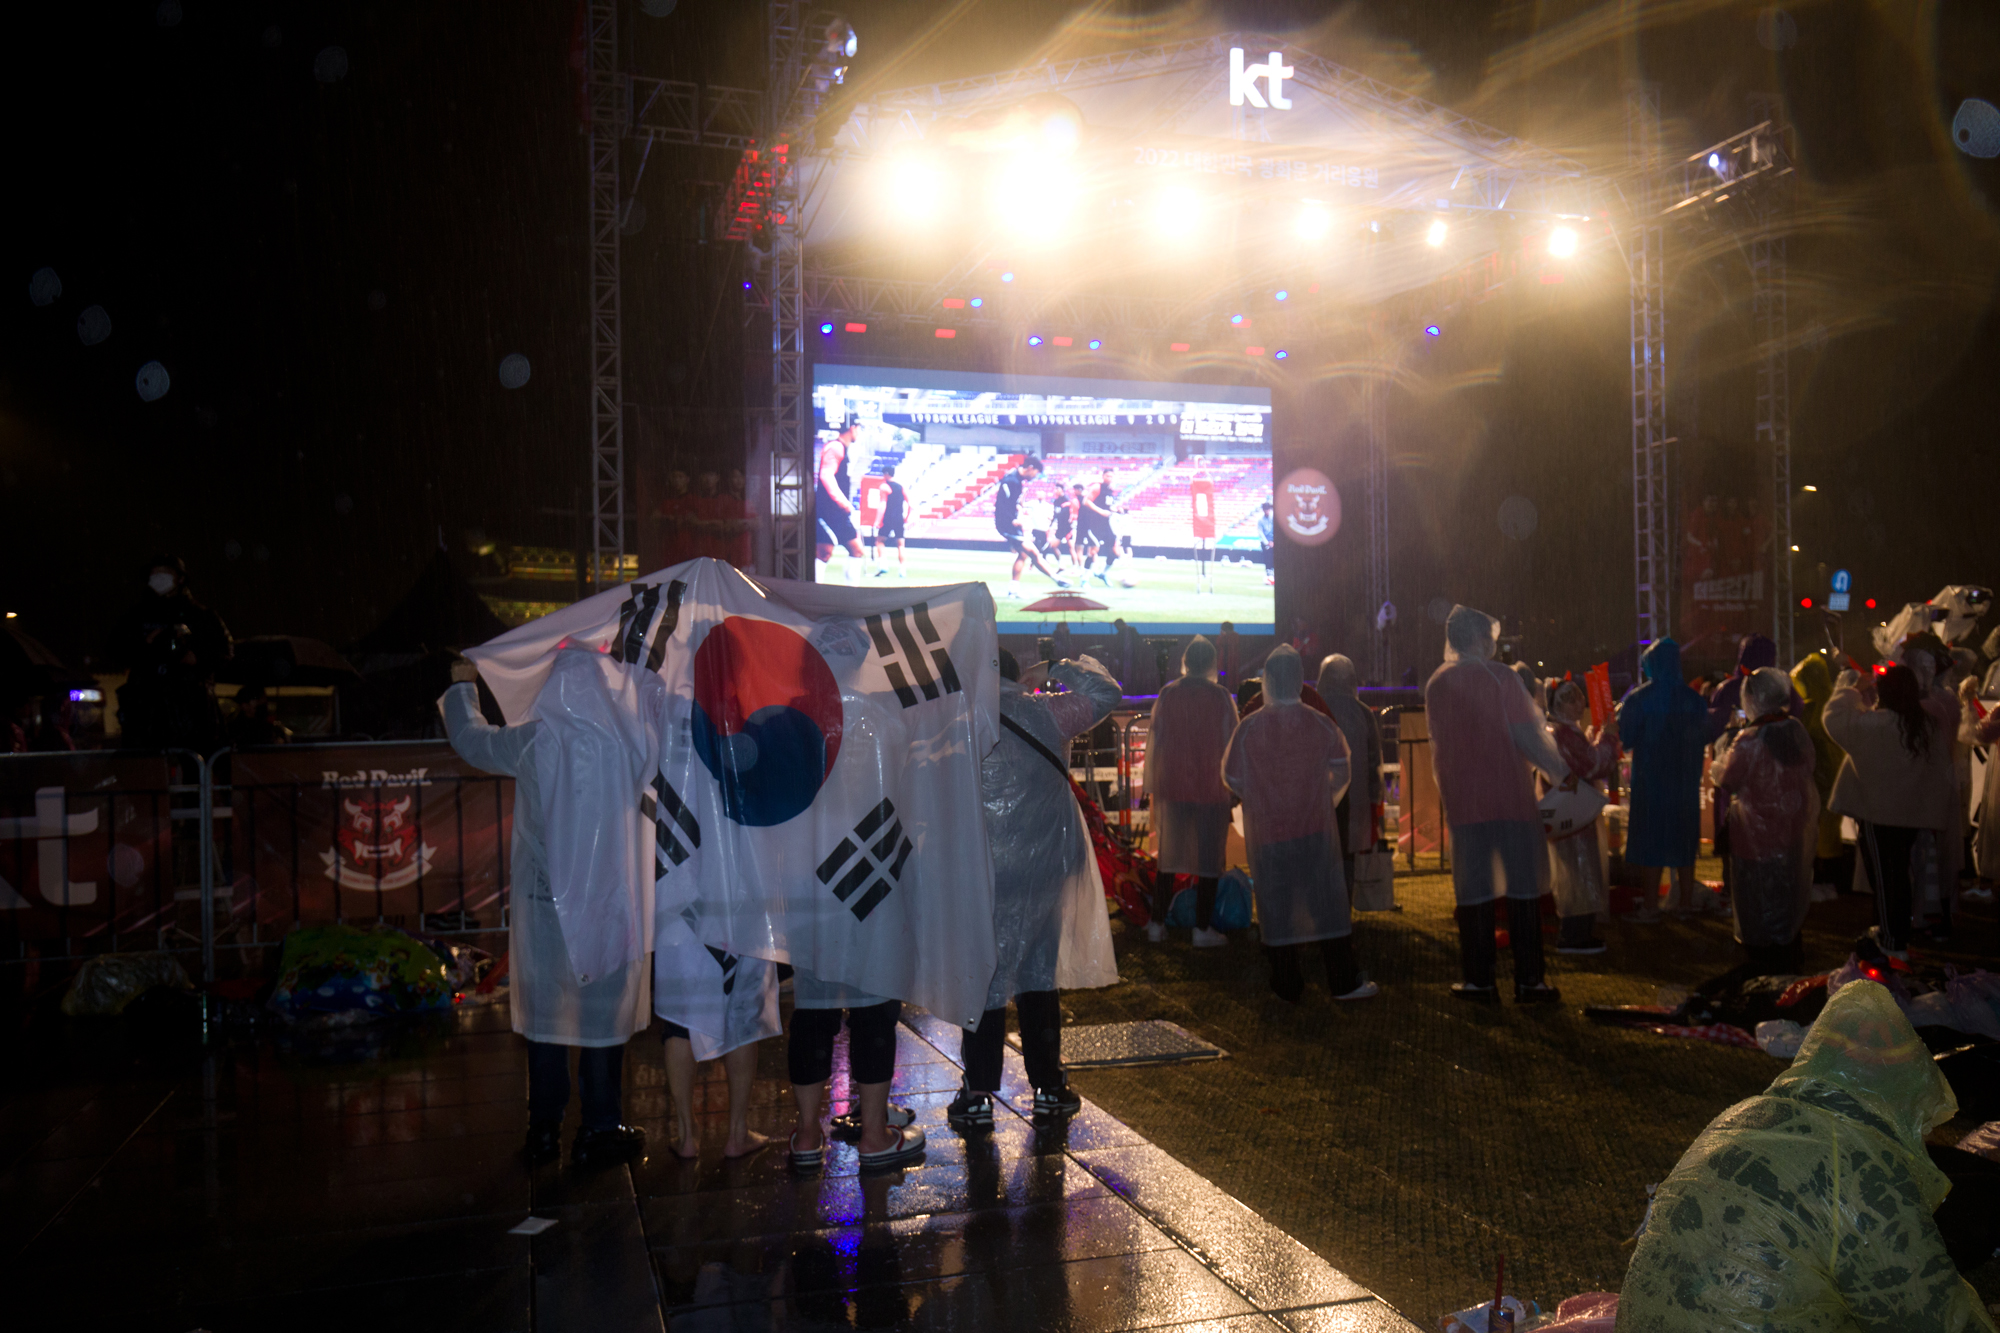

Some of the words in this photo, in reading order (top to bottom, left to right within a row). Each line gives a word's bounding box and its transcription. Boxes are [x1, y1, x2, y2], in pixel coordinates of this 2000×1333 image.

[1230, 47, 1294, 110] kt
[1134, 146, 1179, 168] 2022
[1184, 151, 1254, 177] 대한민국
[1259, 158, 1309, 182] 광화문
[1314, 163, 1380, 189] 거리응원
[956, 414, 999, 425] LEAGUE
[1072, 414, 1117, 425] LEAGUE
[321, 769, 368, 789] Red
